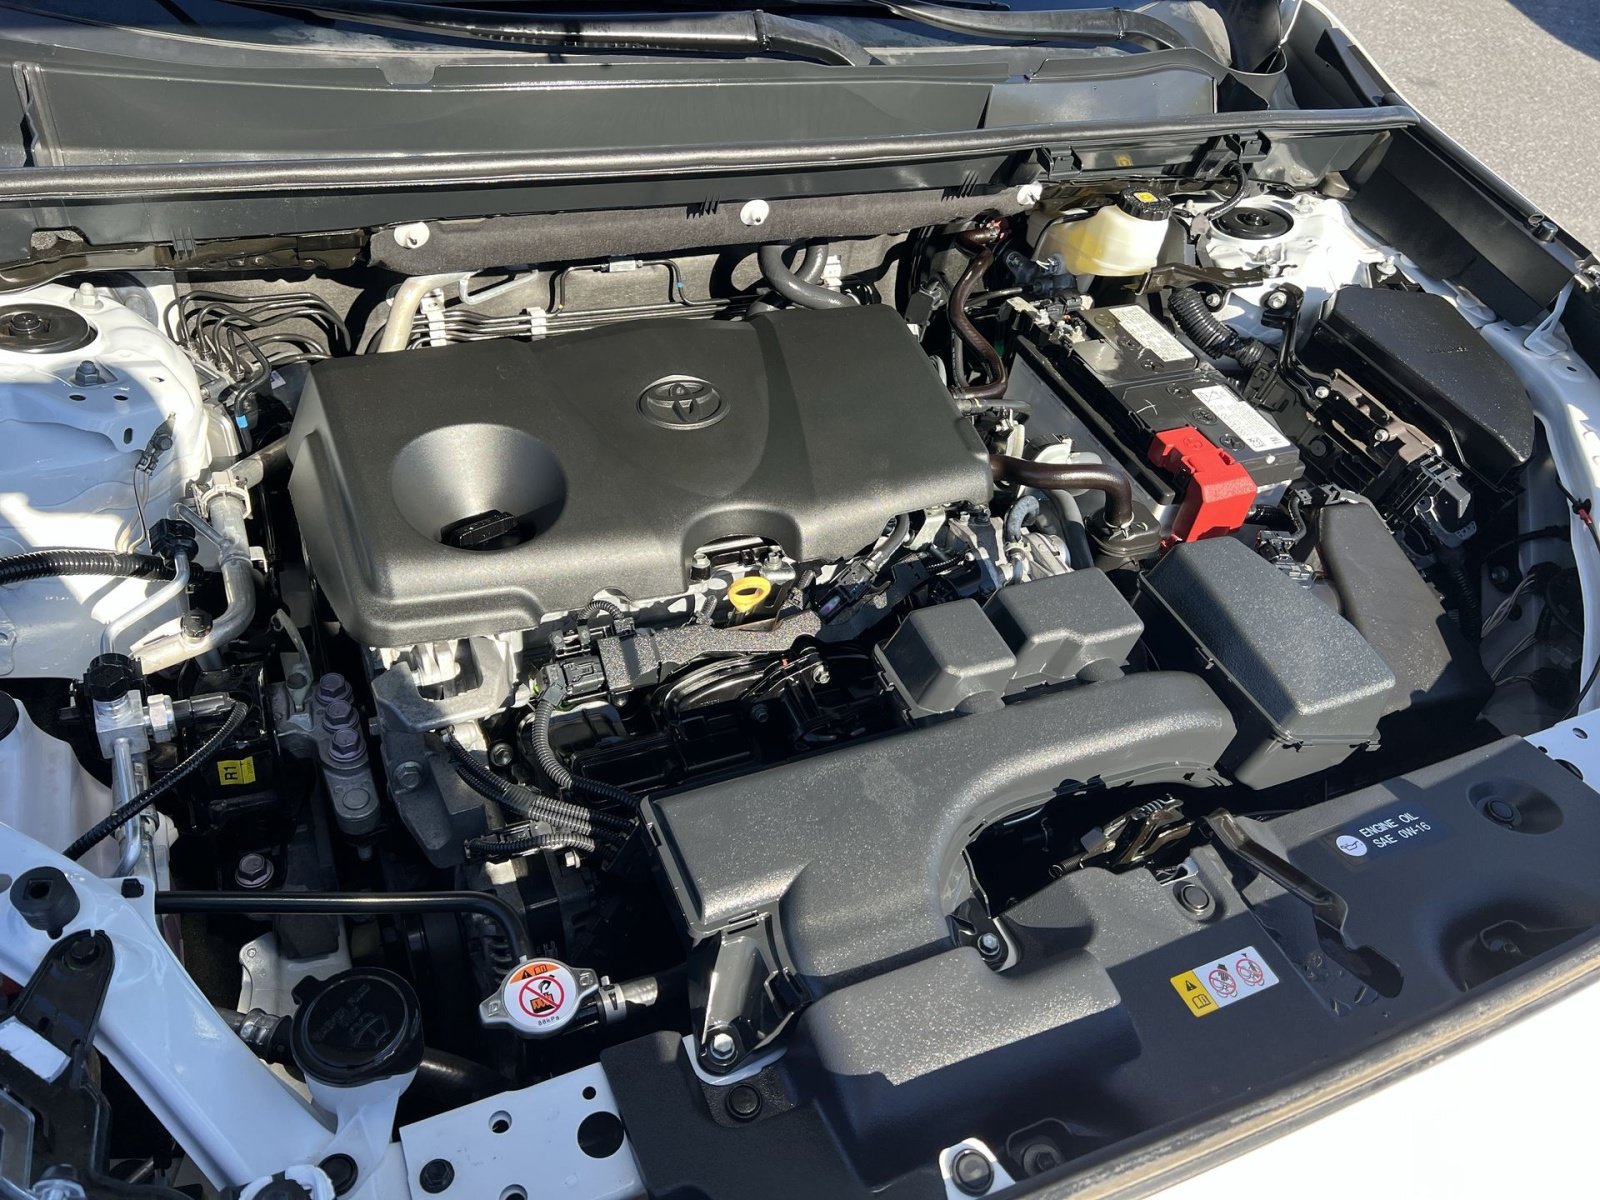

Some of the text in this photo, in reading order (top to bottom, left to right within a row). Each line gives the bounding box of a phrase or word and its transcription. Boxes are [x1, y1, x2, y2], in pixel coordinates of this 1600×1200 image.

[223, 766, 238, 781] R1
[1358, 812, 1419, 838] ENGINE OIL
[1372, 821, 1431, 848] SAE 0W-16
[537, 1015, 560, 1026] 88kPa
